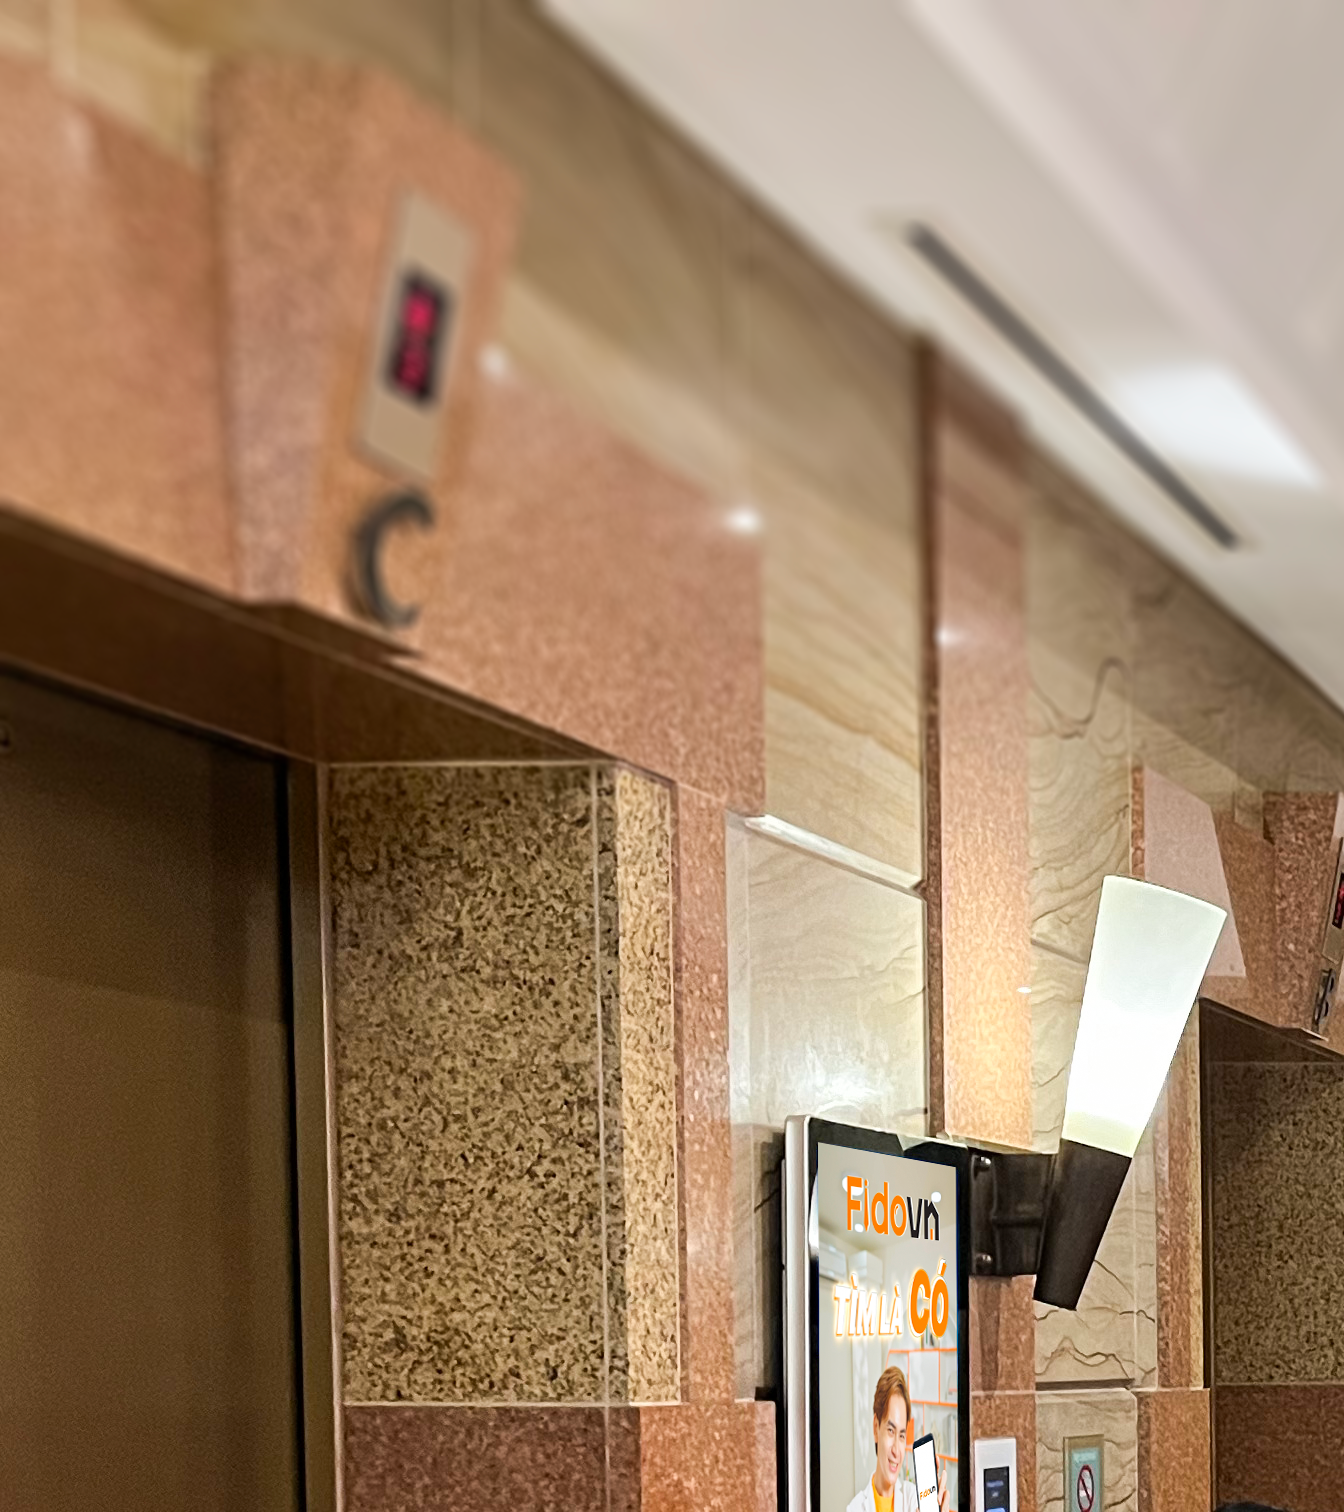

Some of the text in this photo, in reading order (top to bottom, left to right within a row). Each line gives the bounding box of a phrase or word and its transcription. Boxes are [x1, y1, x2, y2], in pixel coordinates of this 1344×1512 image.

[347, 487, 436, 629] C
[847, 1175, 940, 1241] Fidovn
[834, 1258, 949, 1338] TÌM LÀ CÓ
